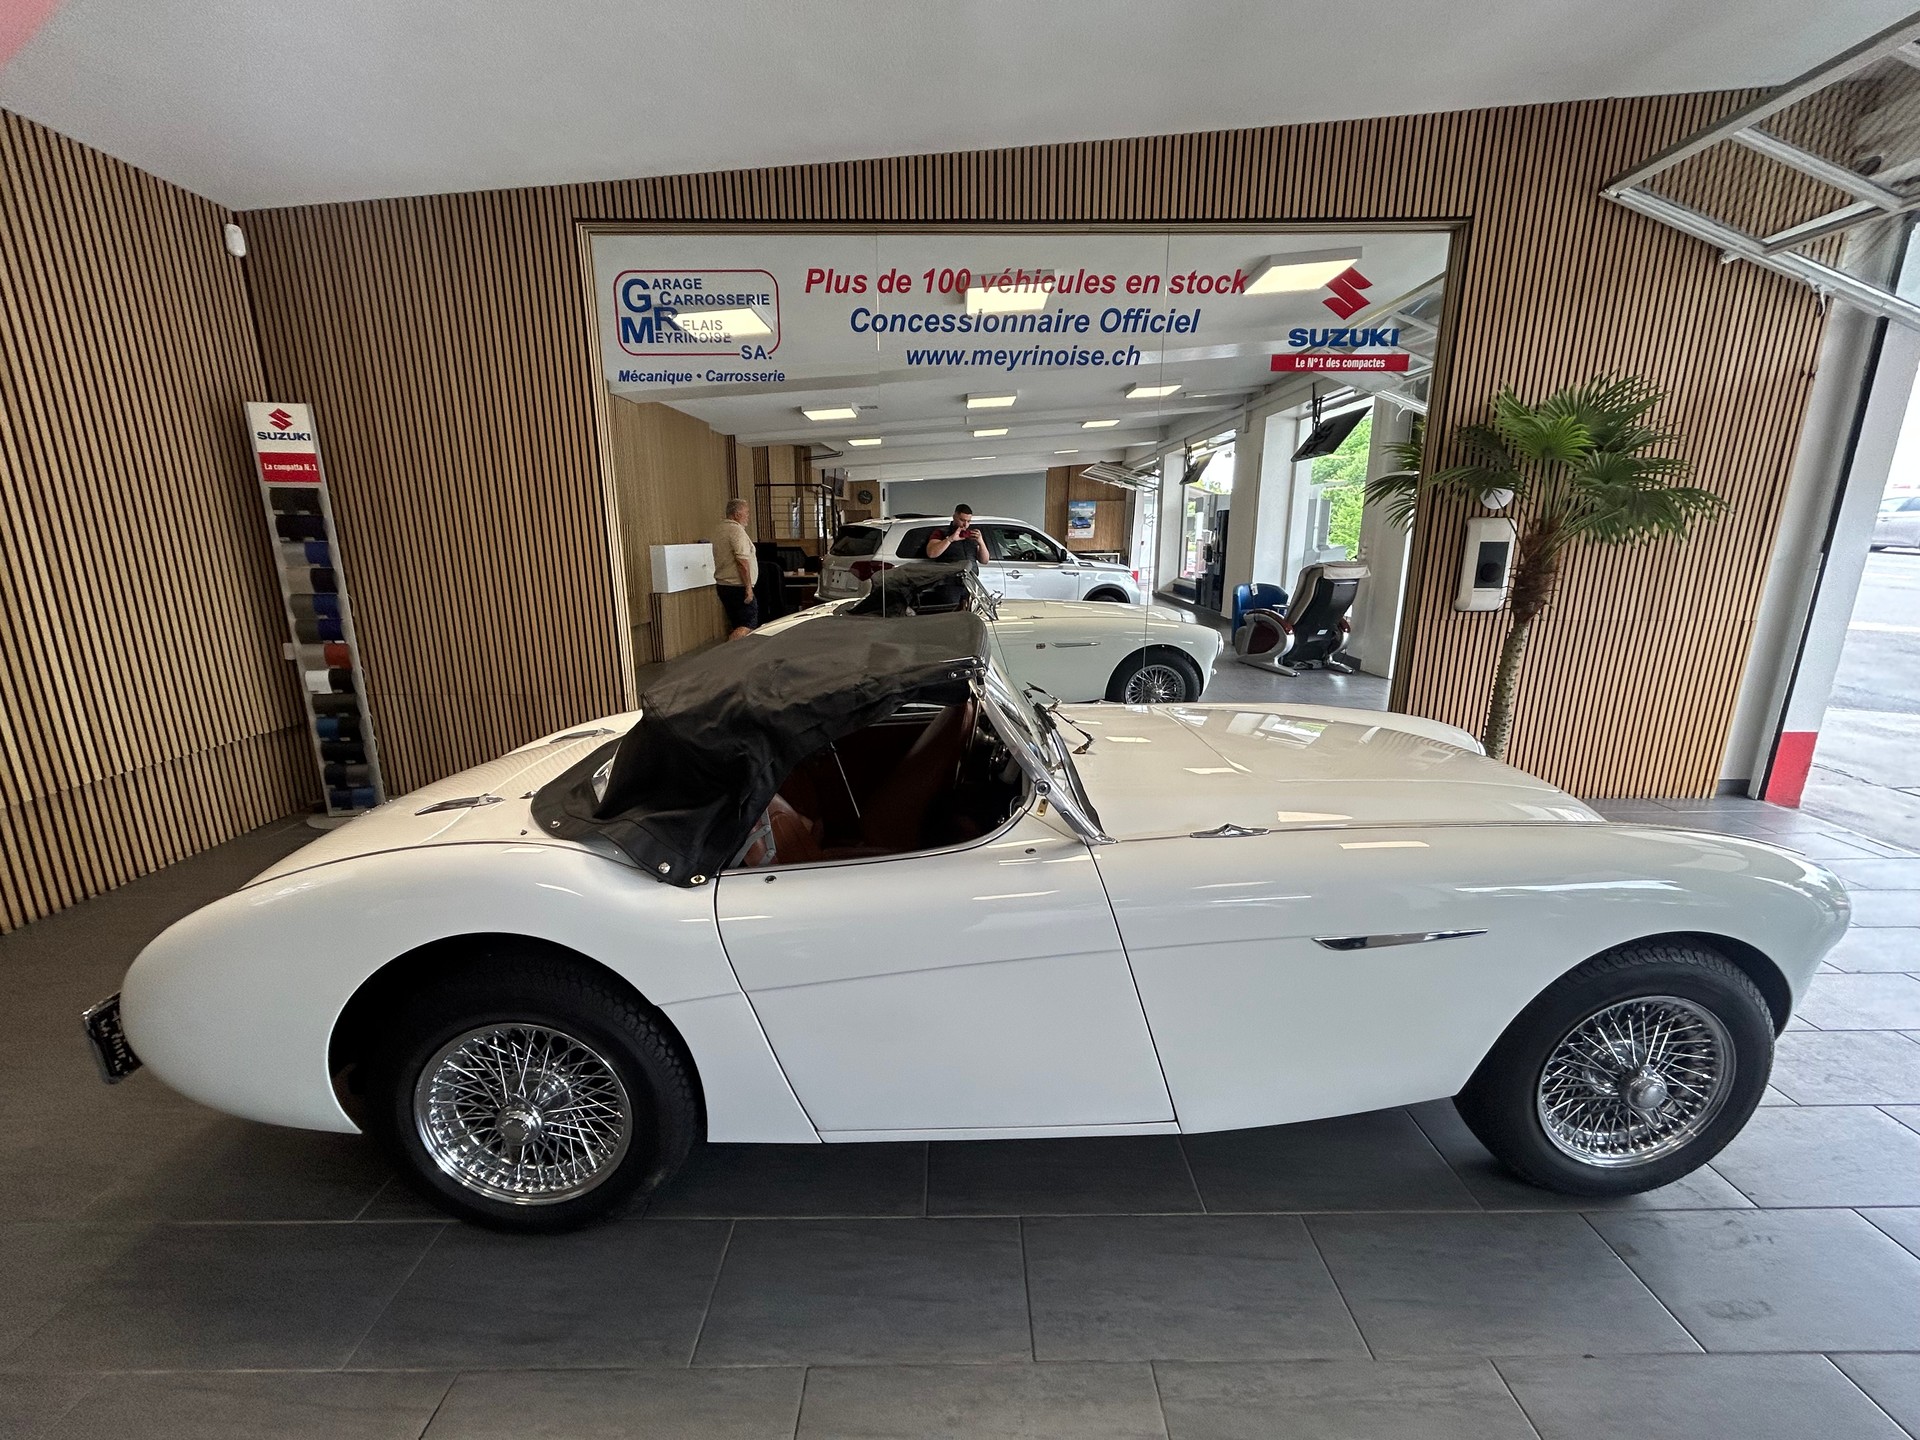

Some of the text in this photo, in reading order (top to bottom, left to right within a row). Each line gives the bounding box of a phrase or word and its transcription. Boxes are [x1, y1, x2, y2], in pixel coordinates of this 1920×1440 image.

[805, 268, 1249, 294] Plus de 100 véhicules en stock
[659, 291, 771, 306] CARROSSERIE
[850, 307, 1202, 333] Concessionnaire Officiel
[1288, 327, 1401, 348] SUZUKI
[906, 345, 1142, 371] www.meyrinoise.ch
[1295, 357, 1305, 368] Le
[1326, 357, 1340, 368] des
[1342, 357, 1386, 370] compactes
[618, 369, 786, 385] Mécanique Carrosserie
[256, 431, 312, 441] SUZUKI
